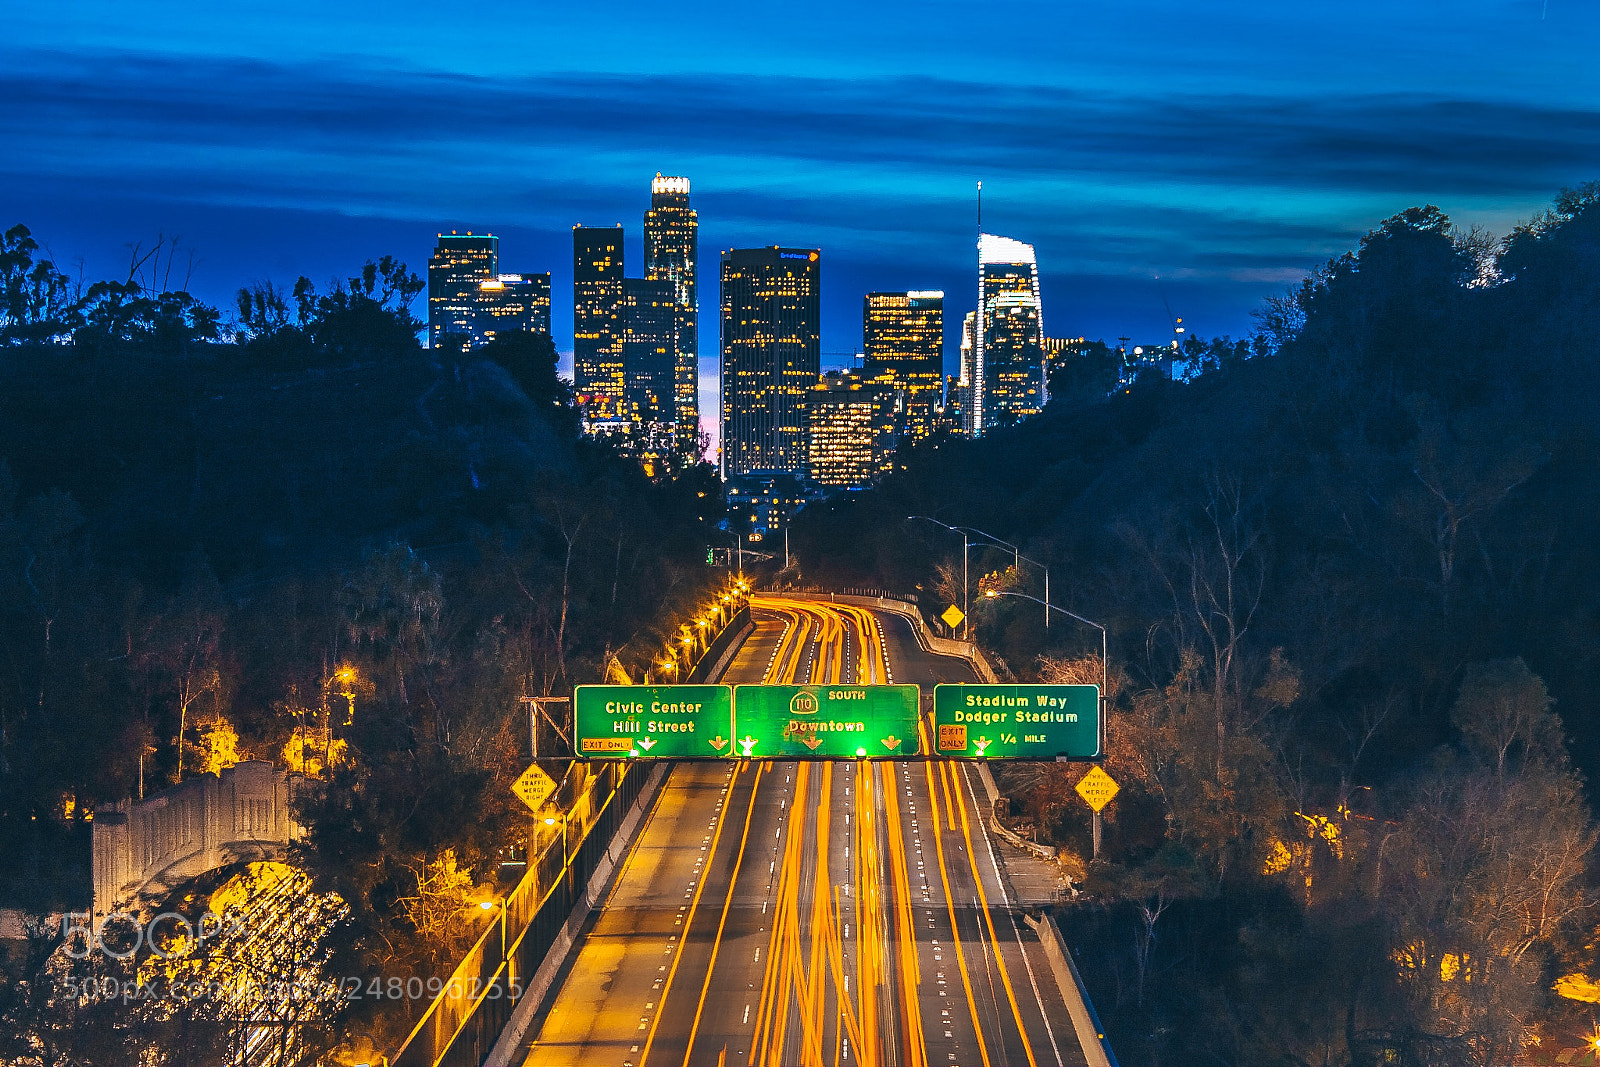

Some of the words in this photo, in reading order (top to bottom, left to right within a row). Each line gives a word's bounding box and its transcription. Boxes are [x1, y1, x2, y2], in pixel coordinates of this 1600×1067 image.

[828, 690, 866, 700] SOUTH
[605, 701, 644, 714] Civic
[651, 701, 702, 714] Center
[795, 698, 812, 710] 110
[966, 695, 1029, 707] Stadium
[1037, 695, 1067, 710] Way
[955, 711, 1008, 726] Dodger
[1015, 711, 1078, 723] Stadium
[613, 720, 640, 733] Hill
[647, 720, 695, 733] Street
[789, 720, 865, 732] Downtown
[941, 727, 965, 736] EXIT
[583, 741, 603, 749] EXIT
[940, 740, 965, 748] ONLY
[1024, 735, 1046, 743] MILE
